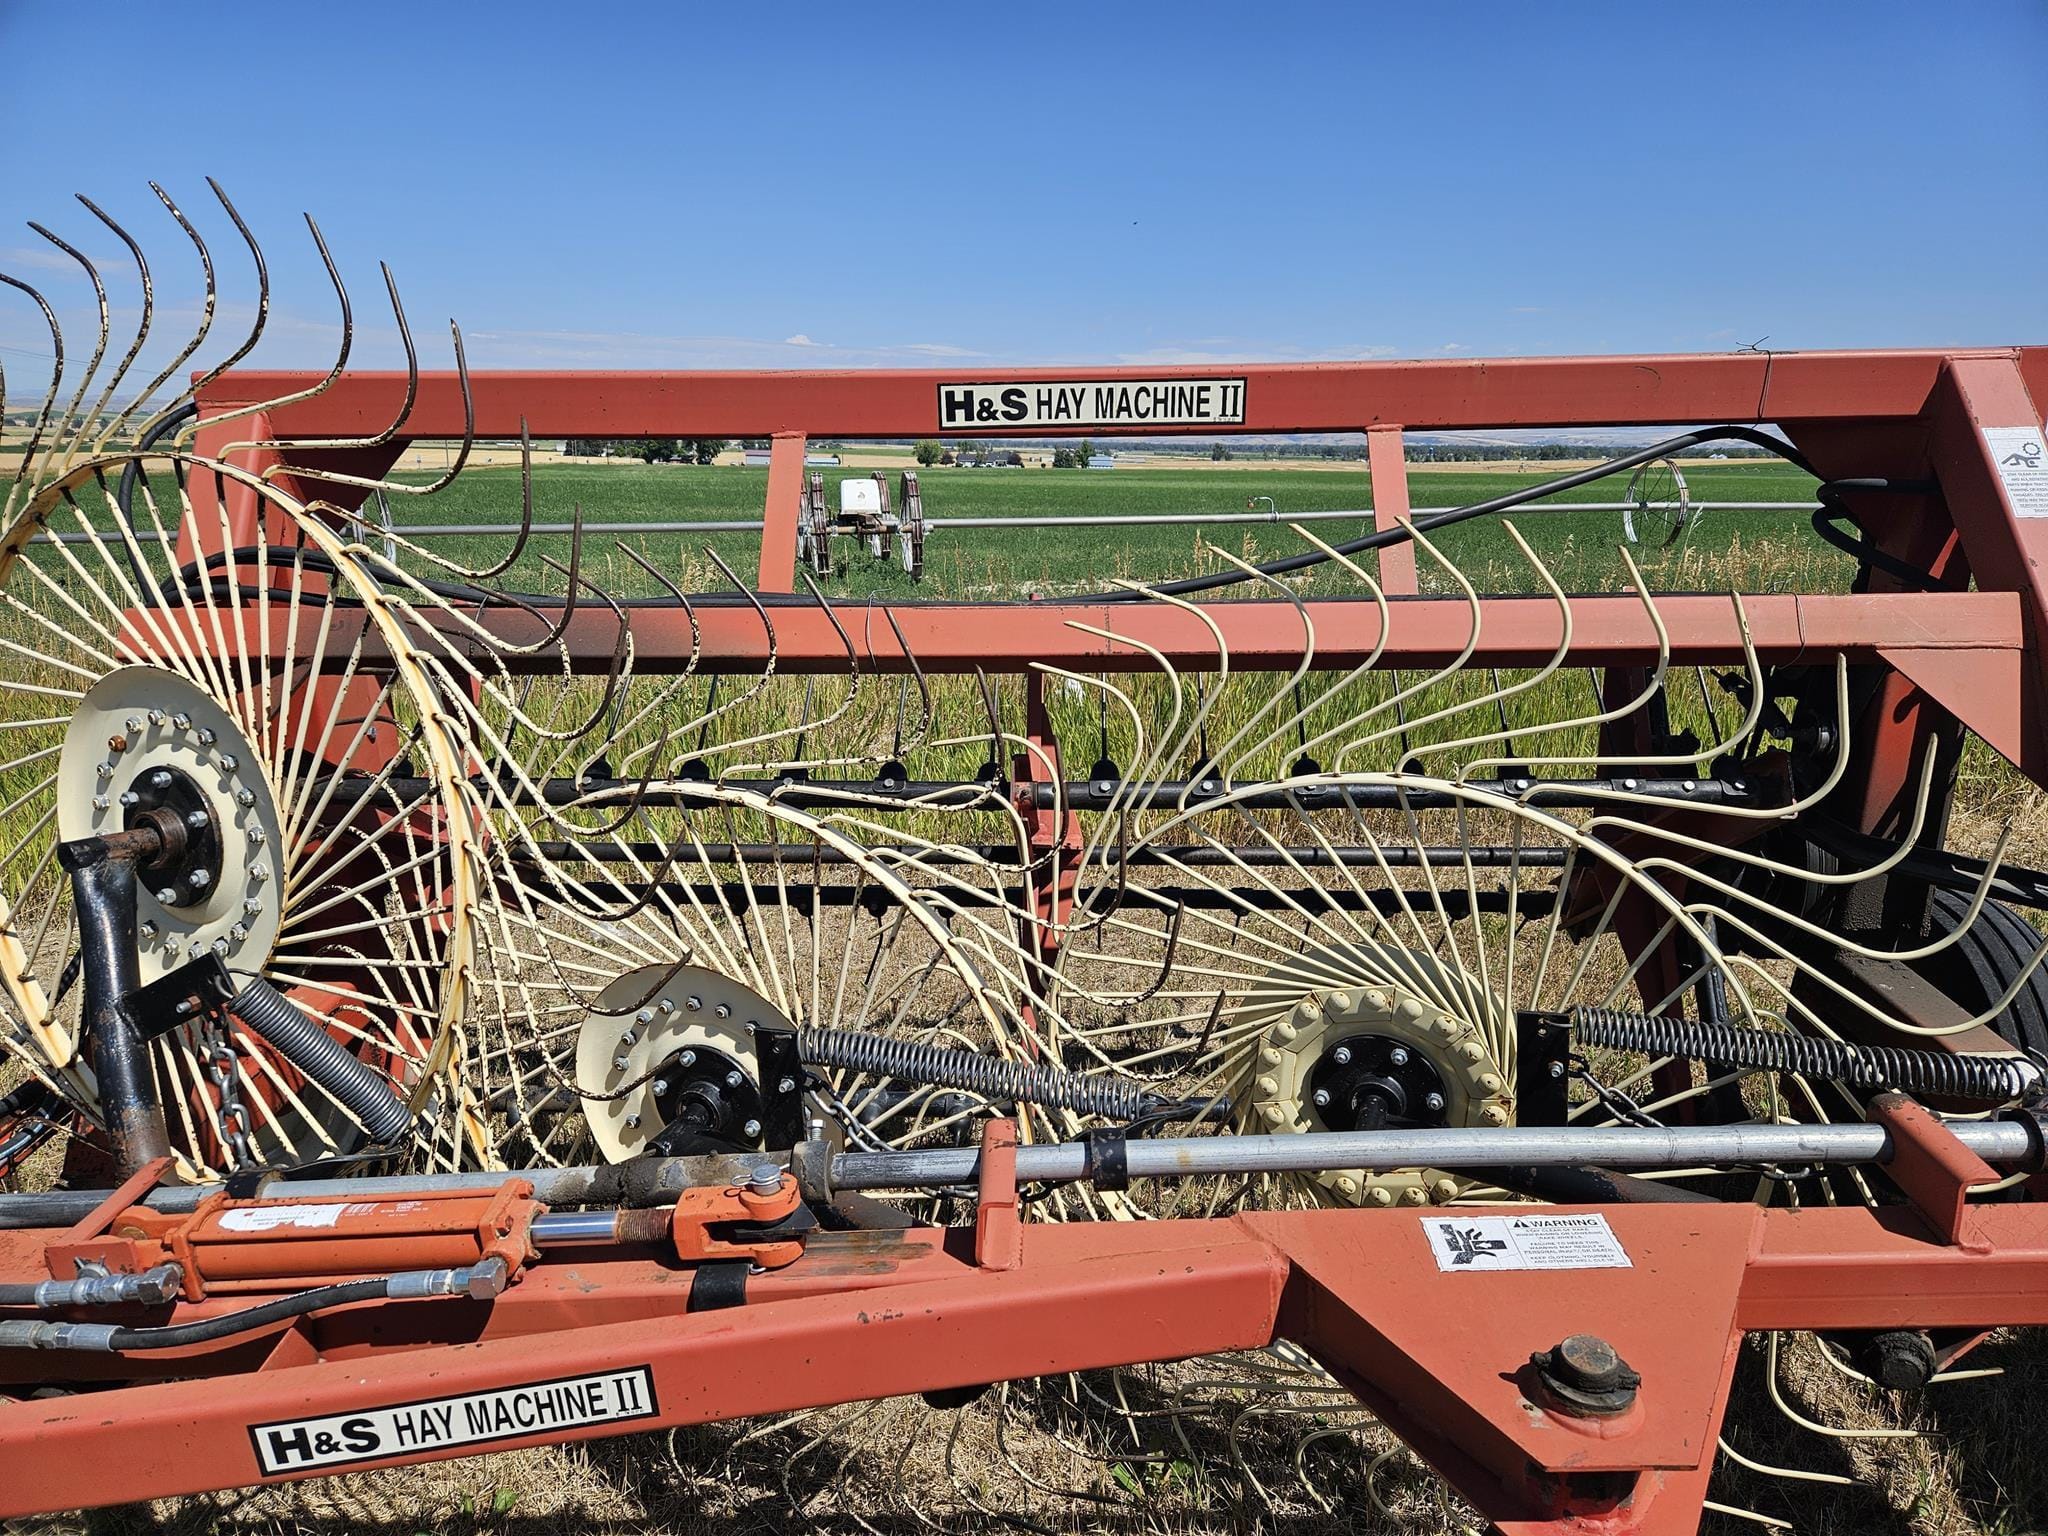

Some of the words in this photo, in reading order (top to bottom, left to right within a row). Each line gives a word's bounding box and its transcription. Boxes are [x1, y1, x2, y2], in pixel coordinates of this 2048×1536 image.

[944, 388, 1029, 422] H&S
[1036, 387, 1086, 420] HAY
[1095, 385, 1211, 419] MACHINE
[1219, 385, 1242, 418] II
[1530, 1219, 1598, 1227] WARNING
[267, 1418, 382, 1465] H&S
[392, 1404, 456, 1447] HAY
[464, 1382, 608, 1436] MACHINE
[612, 1376, 643, 1413] II
